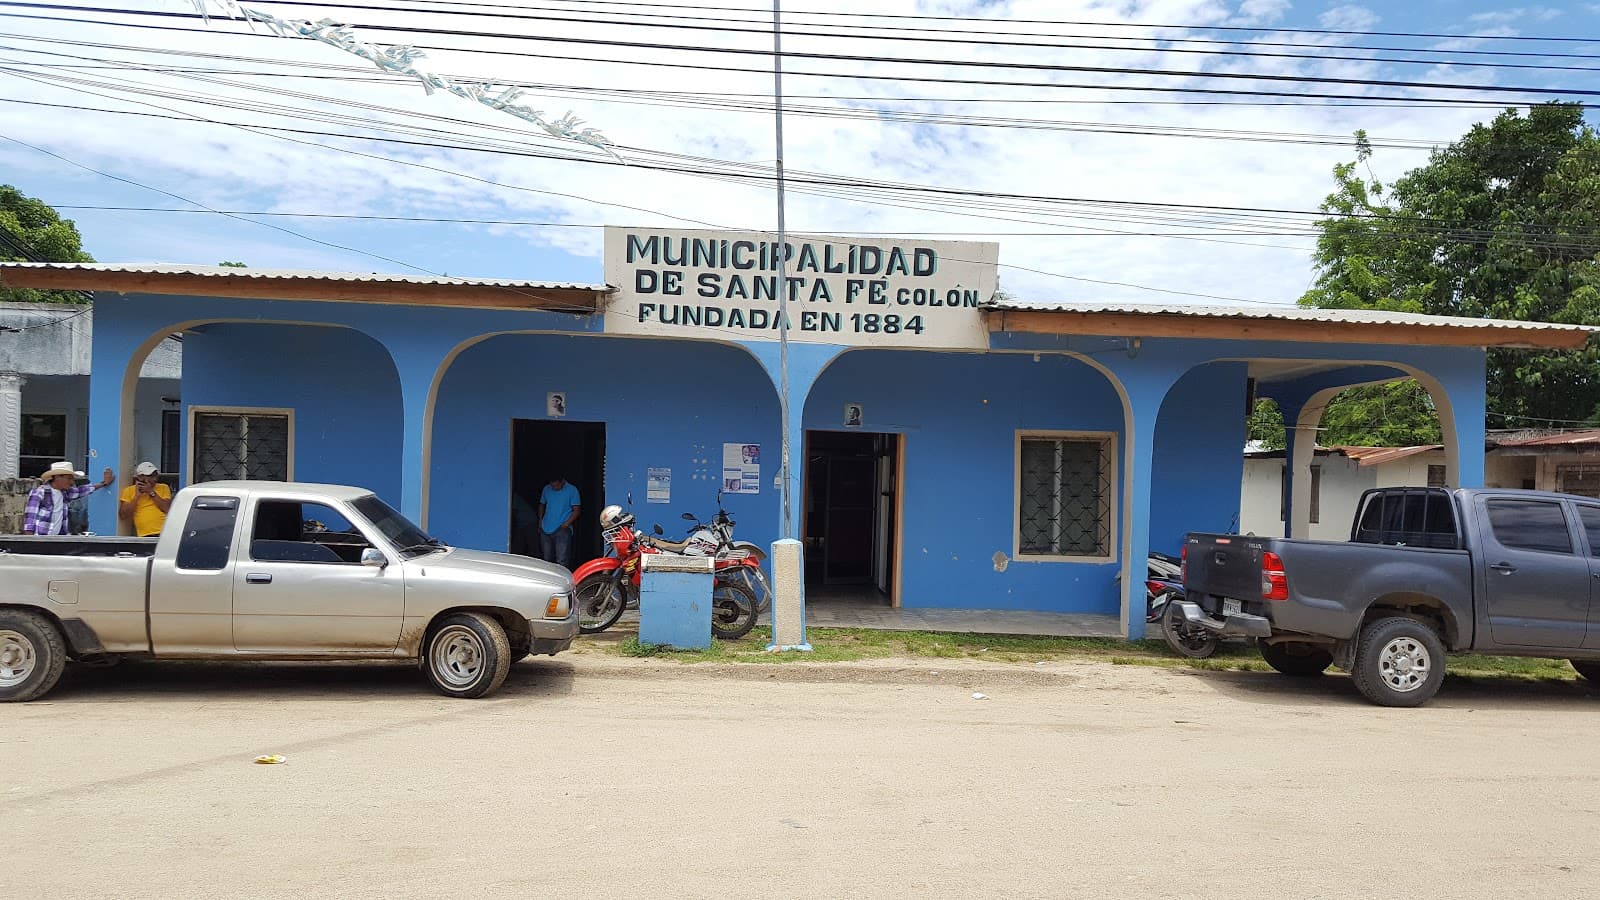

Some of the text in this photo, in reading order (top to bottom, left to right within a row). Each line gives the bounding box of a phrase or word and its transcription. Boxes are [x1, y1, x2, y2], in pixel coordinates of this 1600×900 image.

[636, 269, 684, 295] DE
[697, 272, 832, 304] SANTA
[896, 283, 978, 308] COLÓN
[801, 311, 841, 332] EN
[850, 313, 924, 335] 1884
